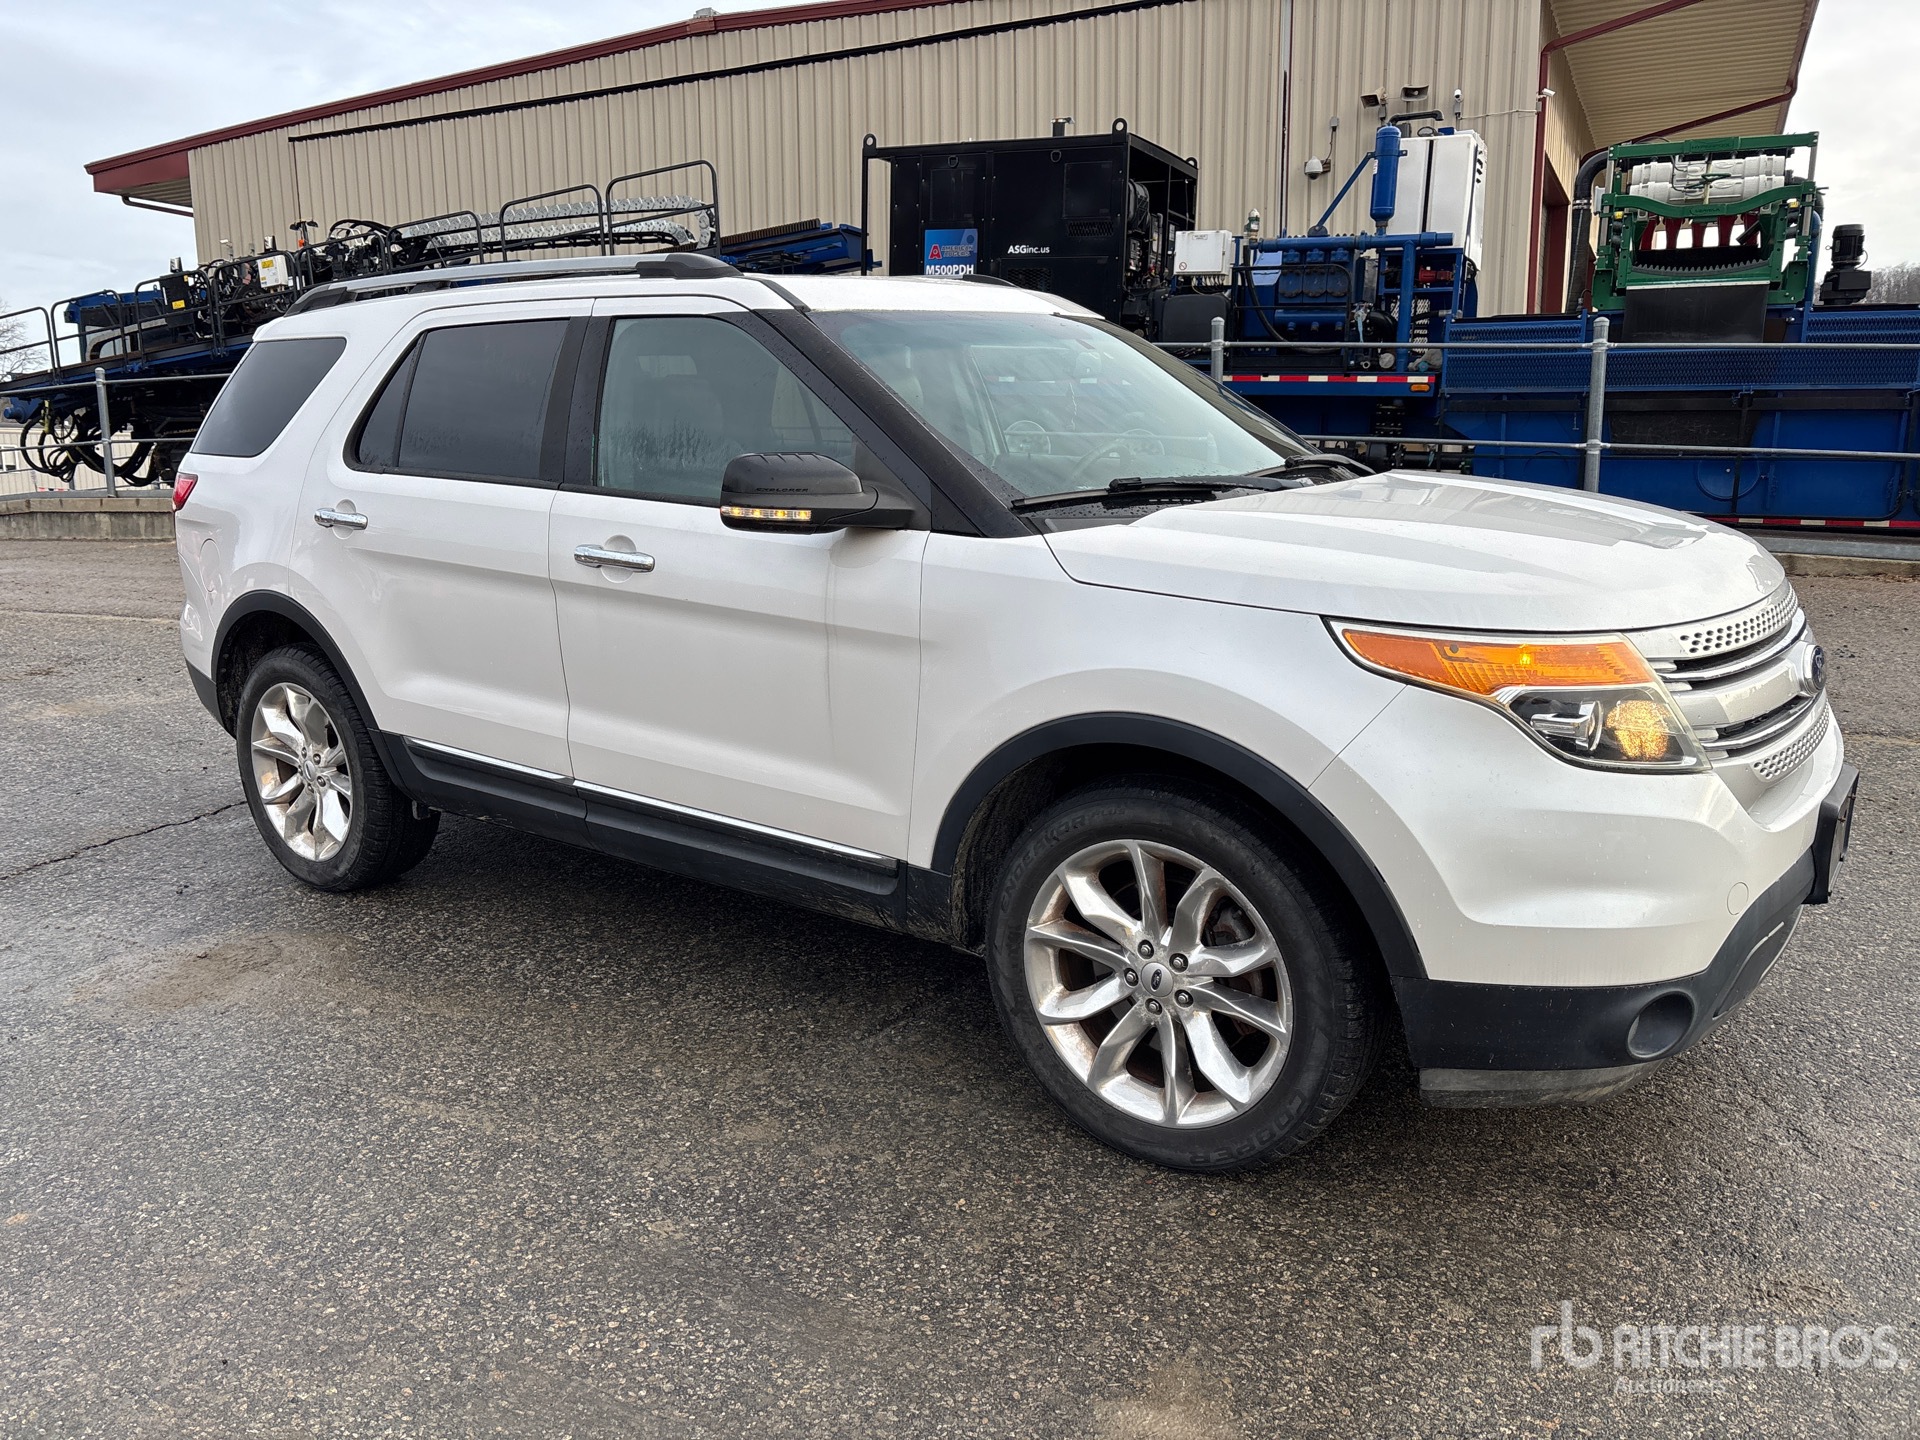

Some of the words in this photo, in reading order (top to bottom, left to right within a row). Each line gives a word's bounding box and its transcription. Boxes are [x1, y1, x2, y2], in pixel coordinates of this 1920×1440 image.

[1007, 245, 1050, 254] ASGinc.us
[926, 264, 974, 275] M500PDH
[1189, 1089, 1306, 1164] COOPER
